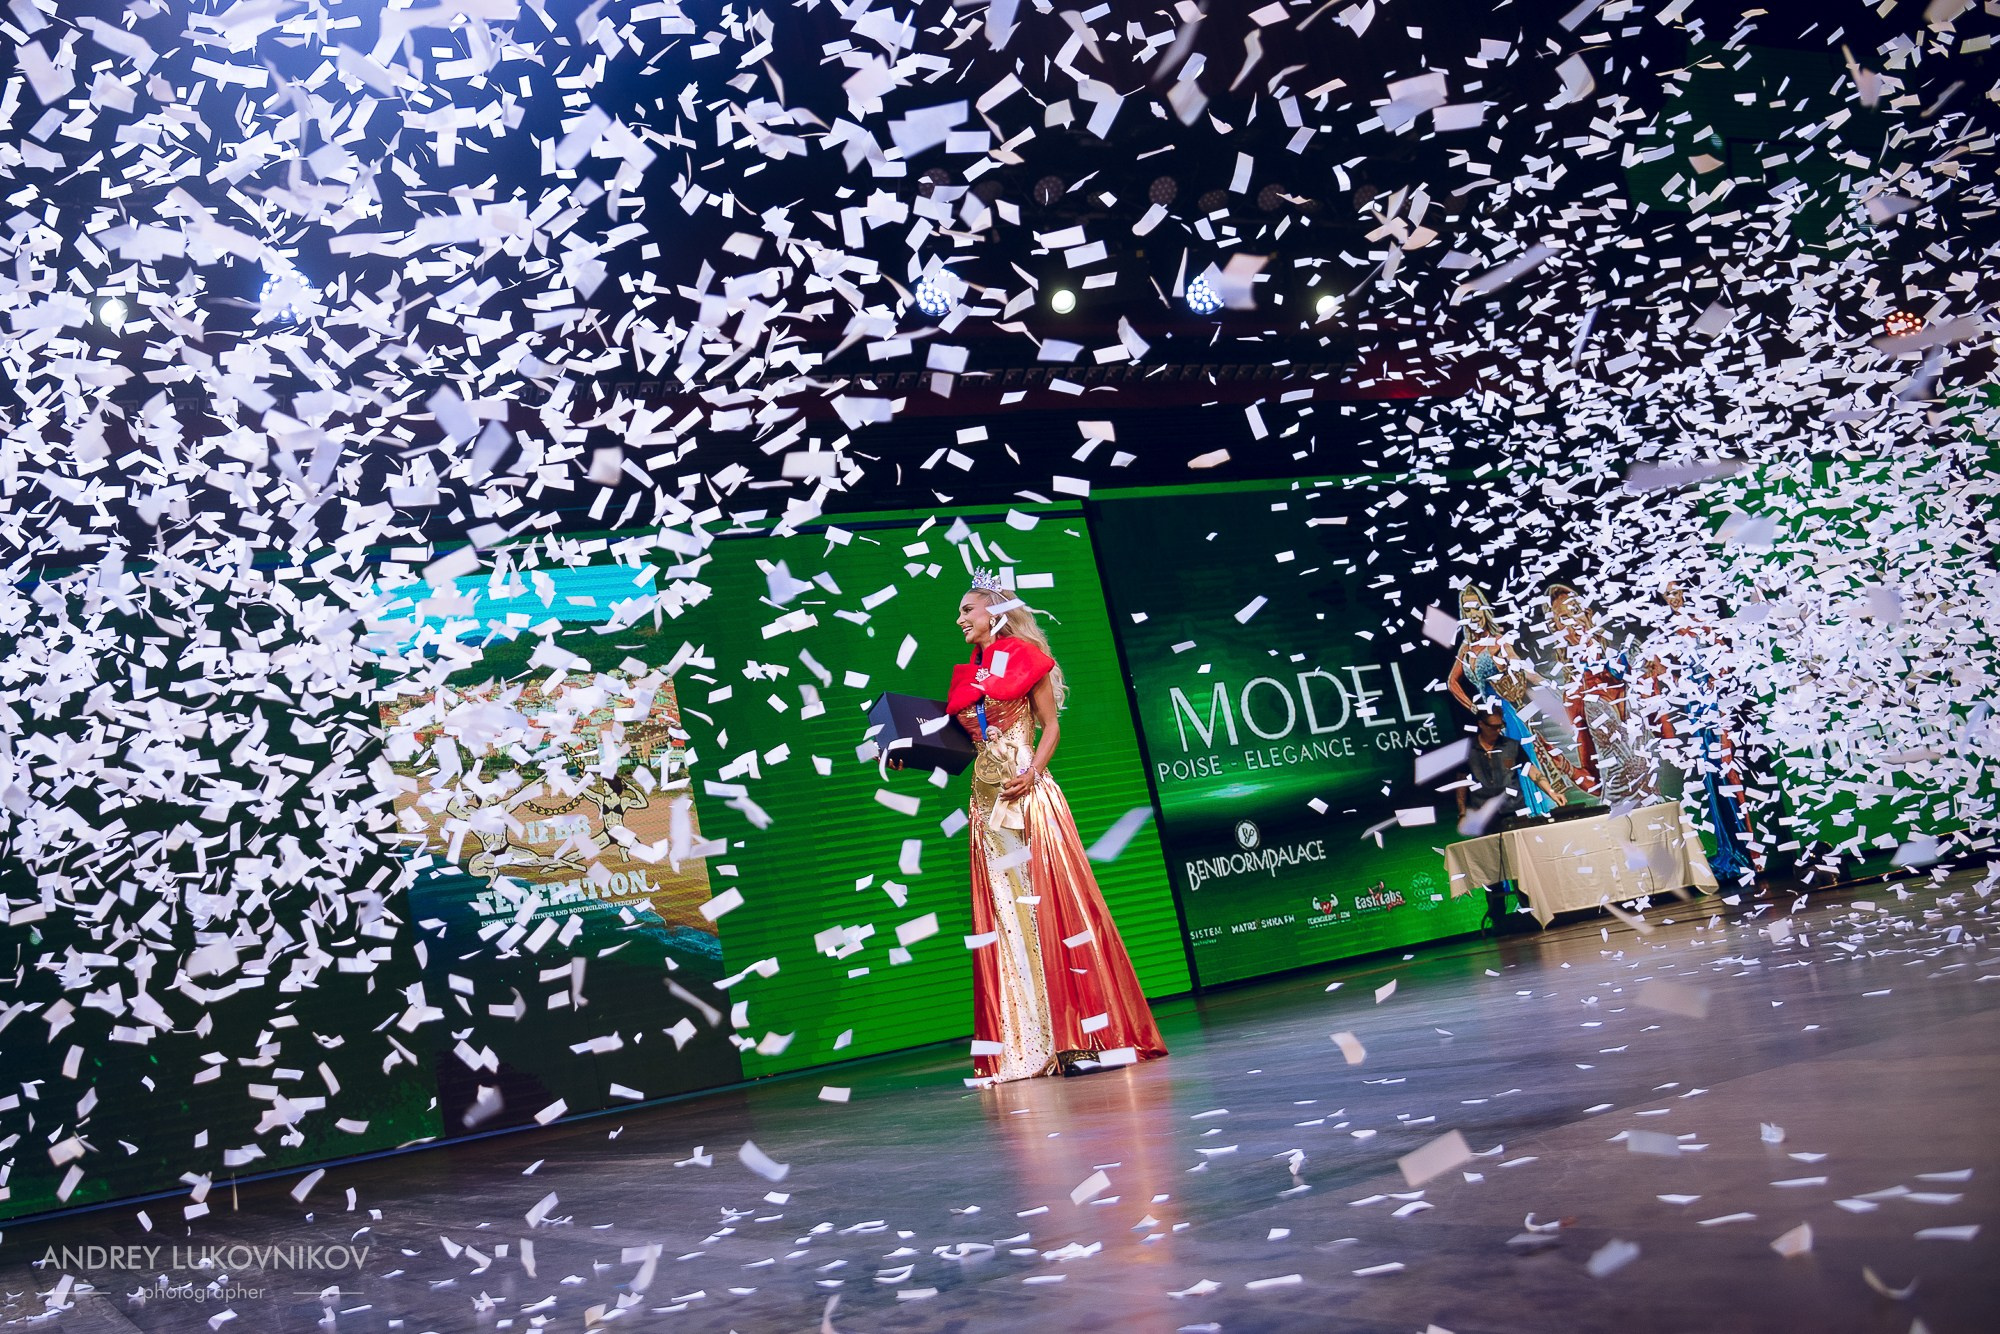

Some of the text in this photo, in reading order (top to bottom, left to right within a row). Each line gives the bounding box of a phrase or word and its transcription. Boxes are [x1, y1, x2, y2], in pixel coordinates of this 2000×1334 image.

[1169, 661, 1435, 752] MODEL
[1157, 755, 1223, 783] POISE
[1244, 737, 1356, 770] ELEGANCE
[1375, 725, 1441, 752] GRACE
[556, 908, 568, 917] AND
